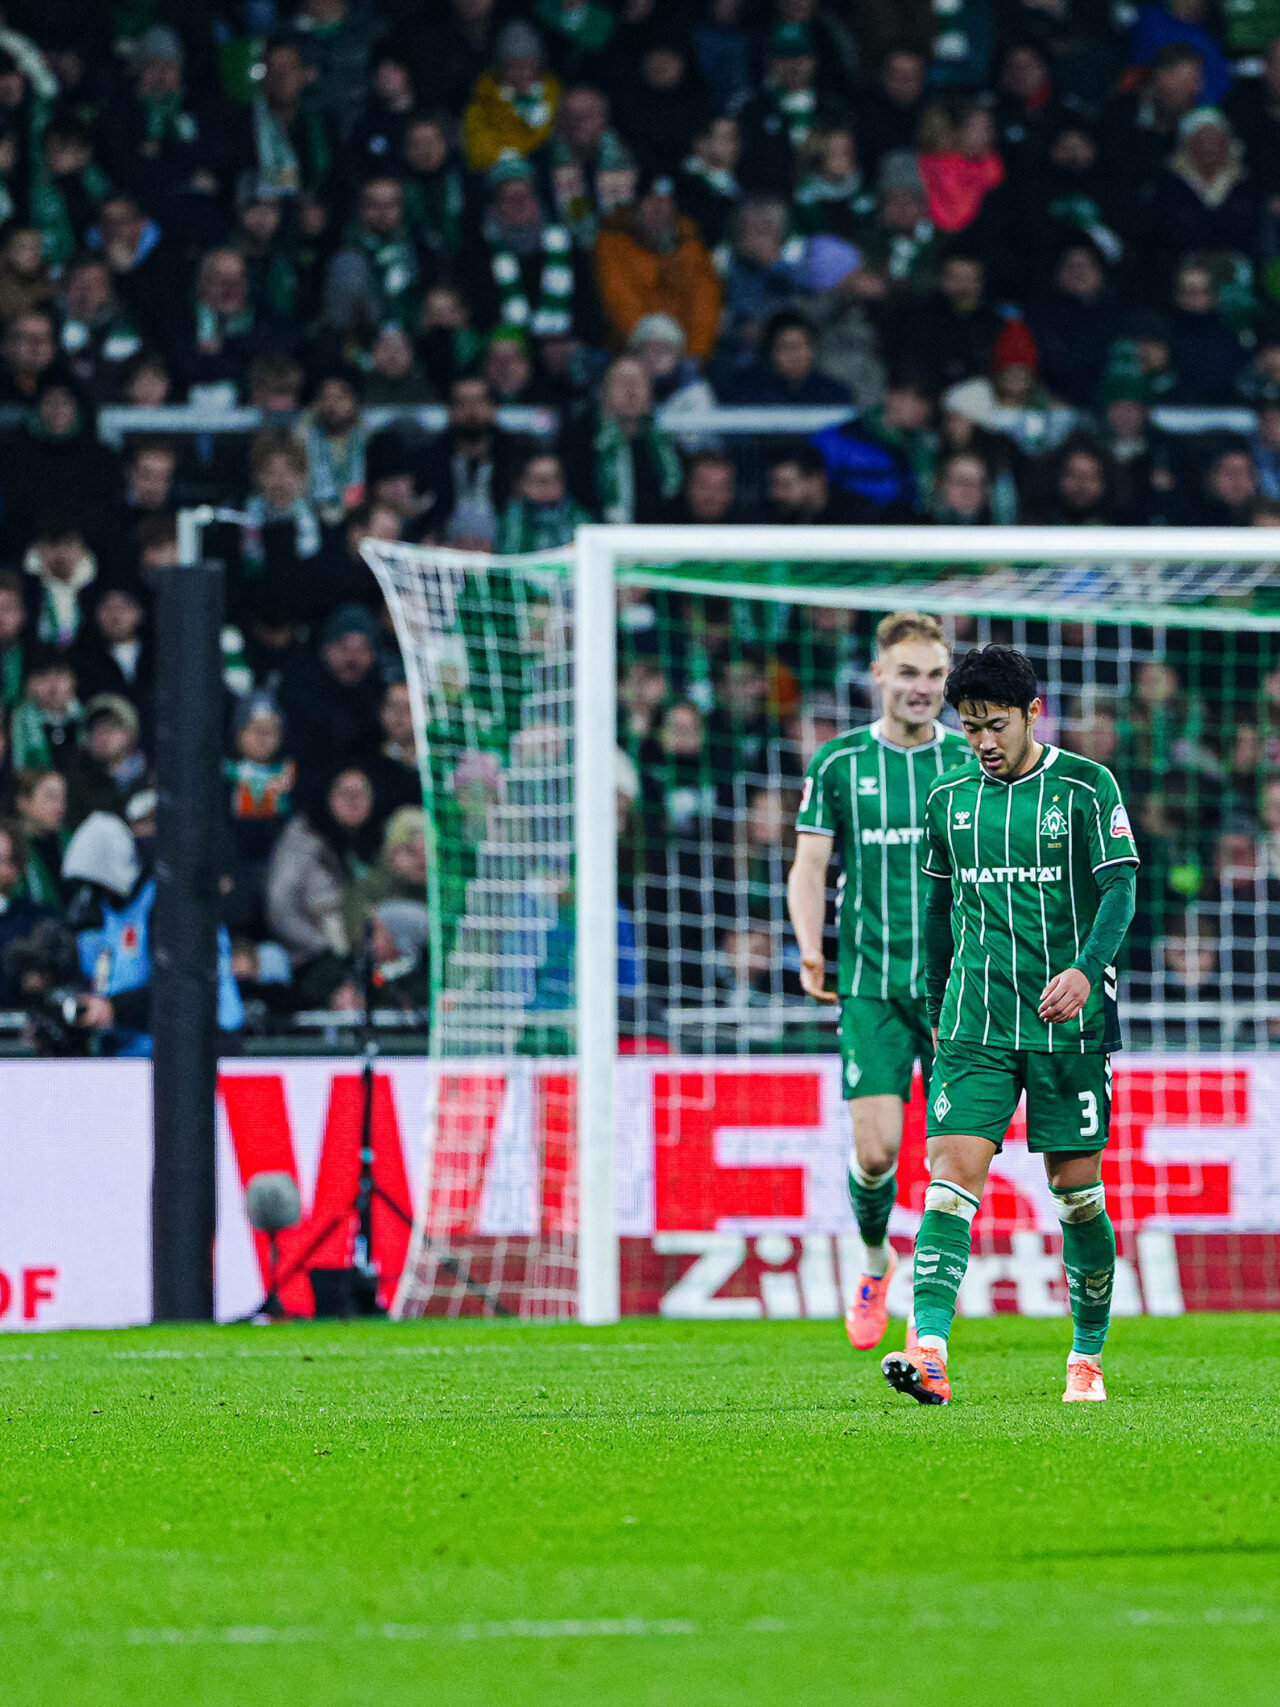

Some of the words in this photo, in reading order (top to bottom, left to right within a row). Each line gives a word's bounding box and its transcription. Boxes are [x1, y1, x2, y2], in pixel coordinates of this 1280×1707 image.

[861, 827, 926, 845] MATT
[960, 866, 1062, 884] MATTHÄI
[1077, 1090, 1100, 1137] 3
